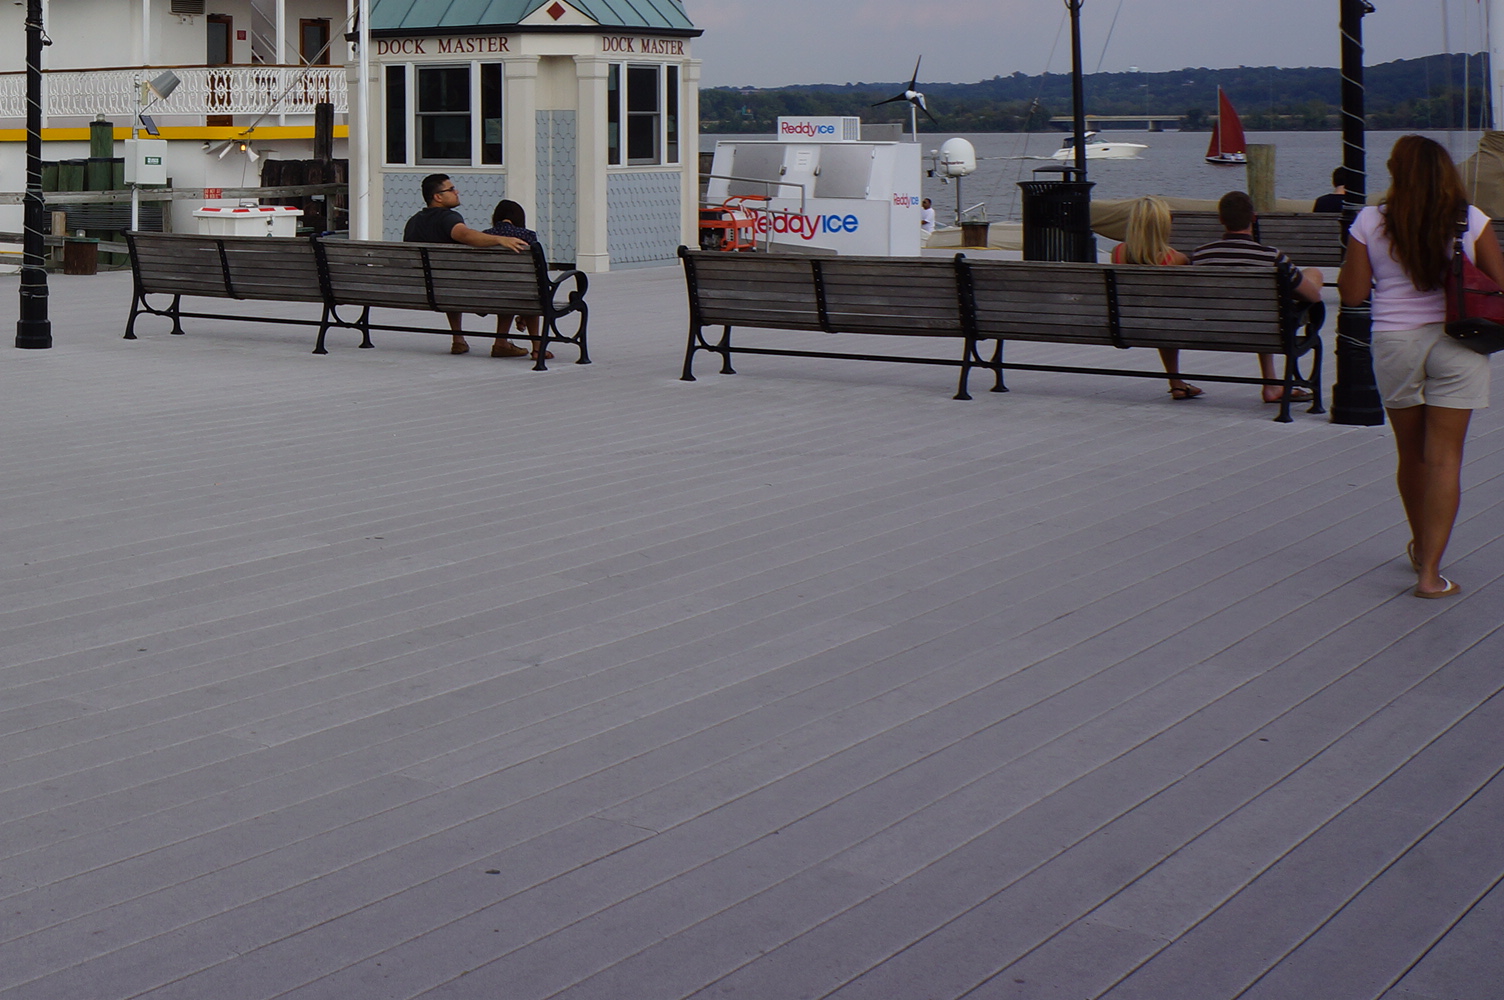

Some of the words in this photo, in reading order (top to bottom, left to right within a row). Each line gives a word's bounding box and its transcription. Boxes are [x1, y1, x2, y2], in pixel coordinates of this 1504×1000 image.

[377, 38, 426, 55] DOCK
[437, 36, 510, 54] MASTER
[602, 36, 635, 53] DOCK
[640, 38, 685, 56] MASTER
